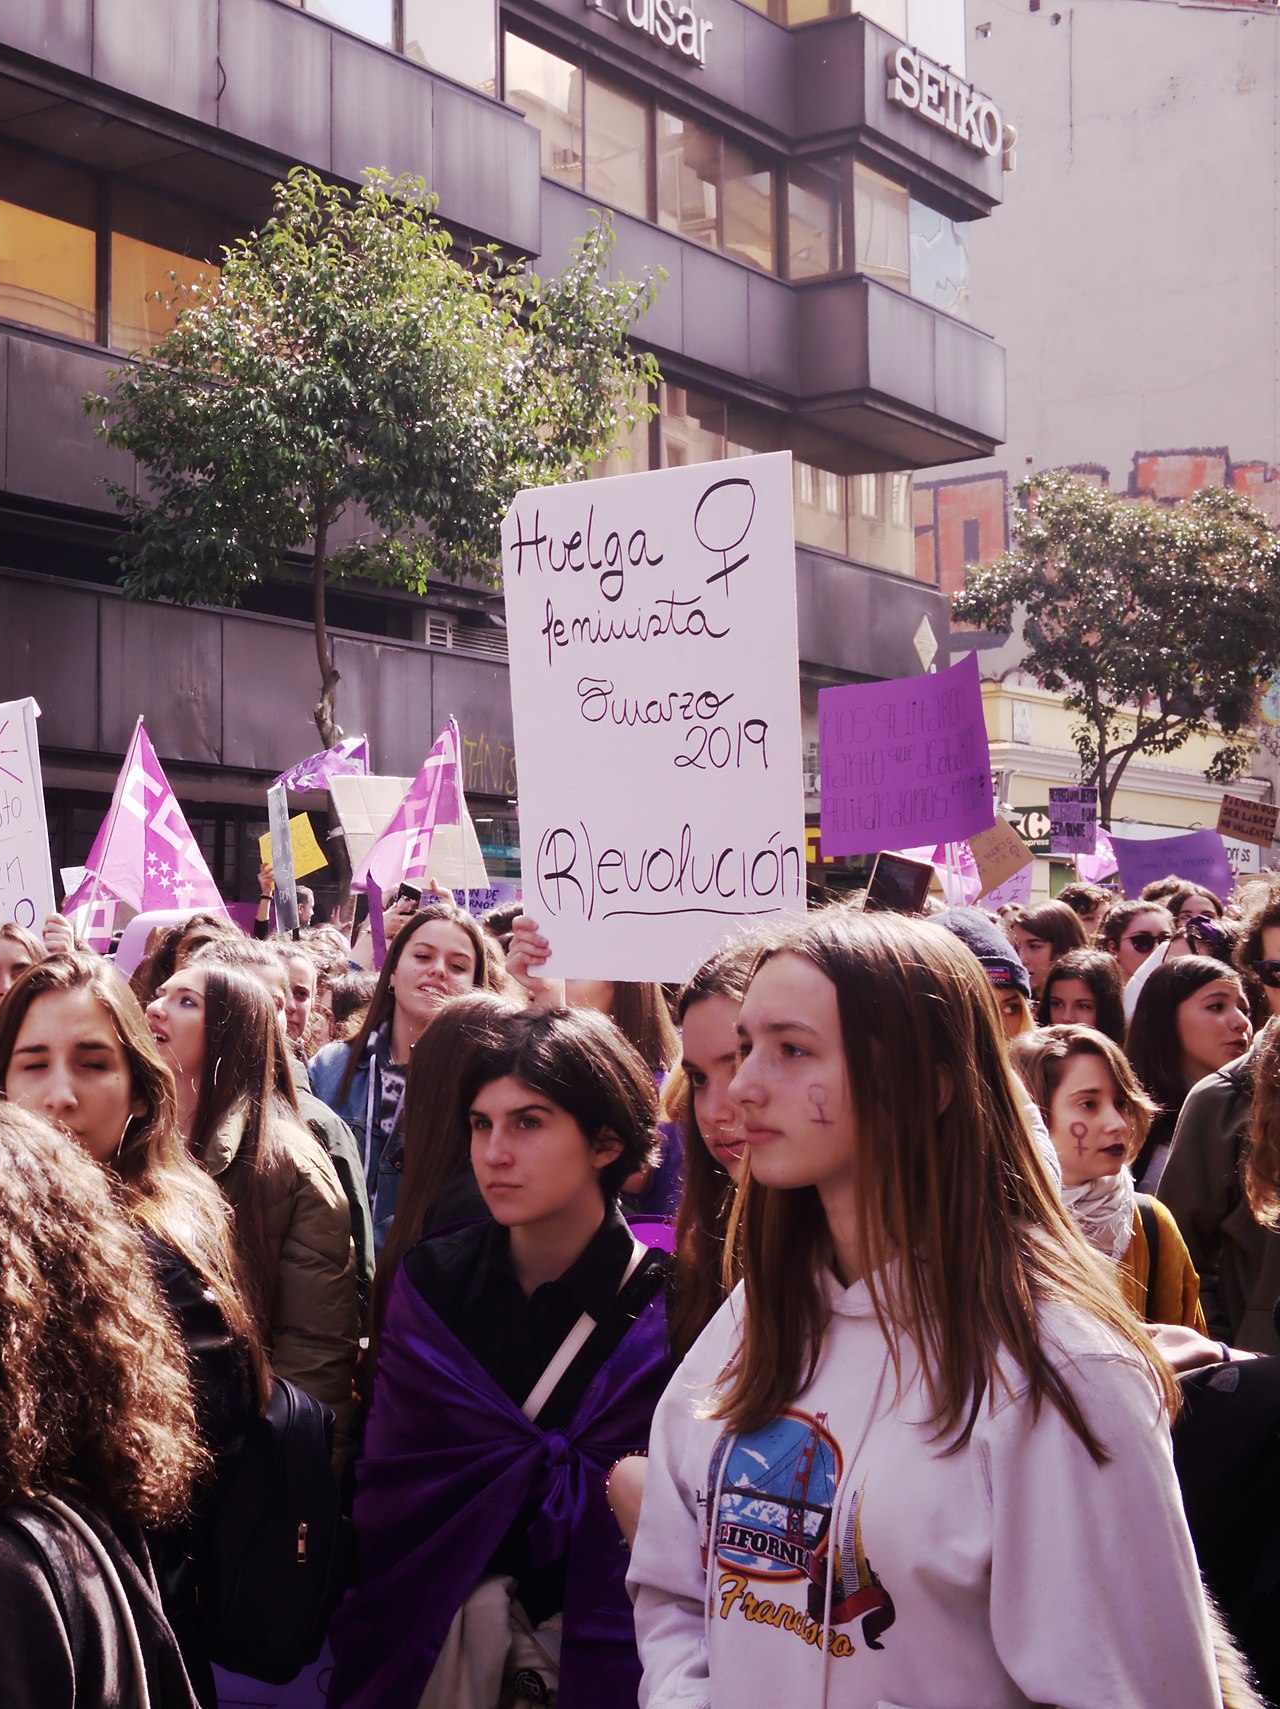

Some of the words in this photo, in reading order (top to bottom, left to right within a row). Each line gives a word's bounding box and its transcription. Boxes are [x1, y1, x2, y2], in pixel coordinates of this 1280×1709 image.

[894, 46, 1001, 156] SEIKO
[510, 504, 664, 602] Huelga
[673, 718, 769, 770] 2019
[537, 821, 801, 922] (R)evolución
